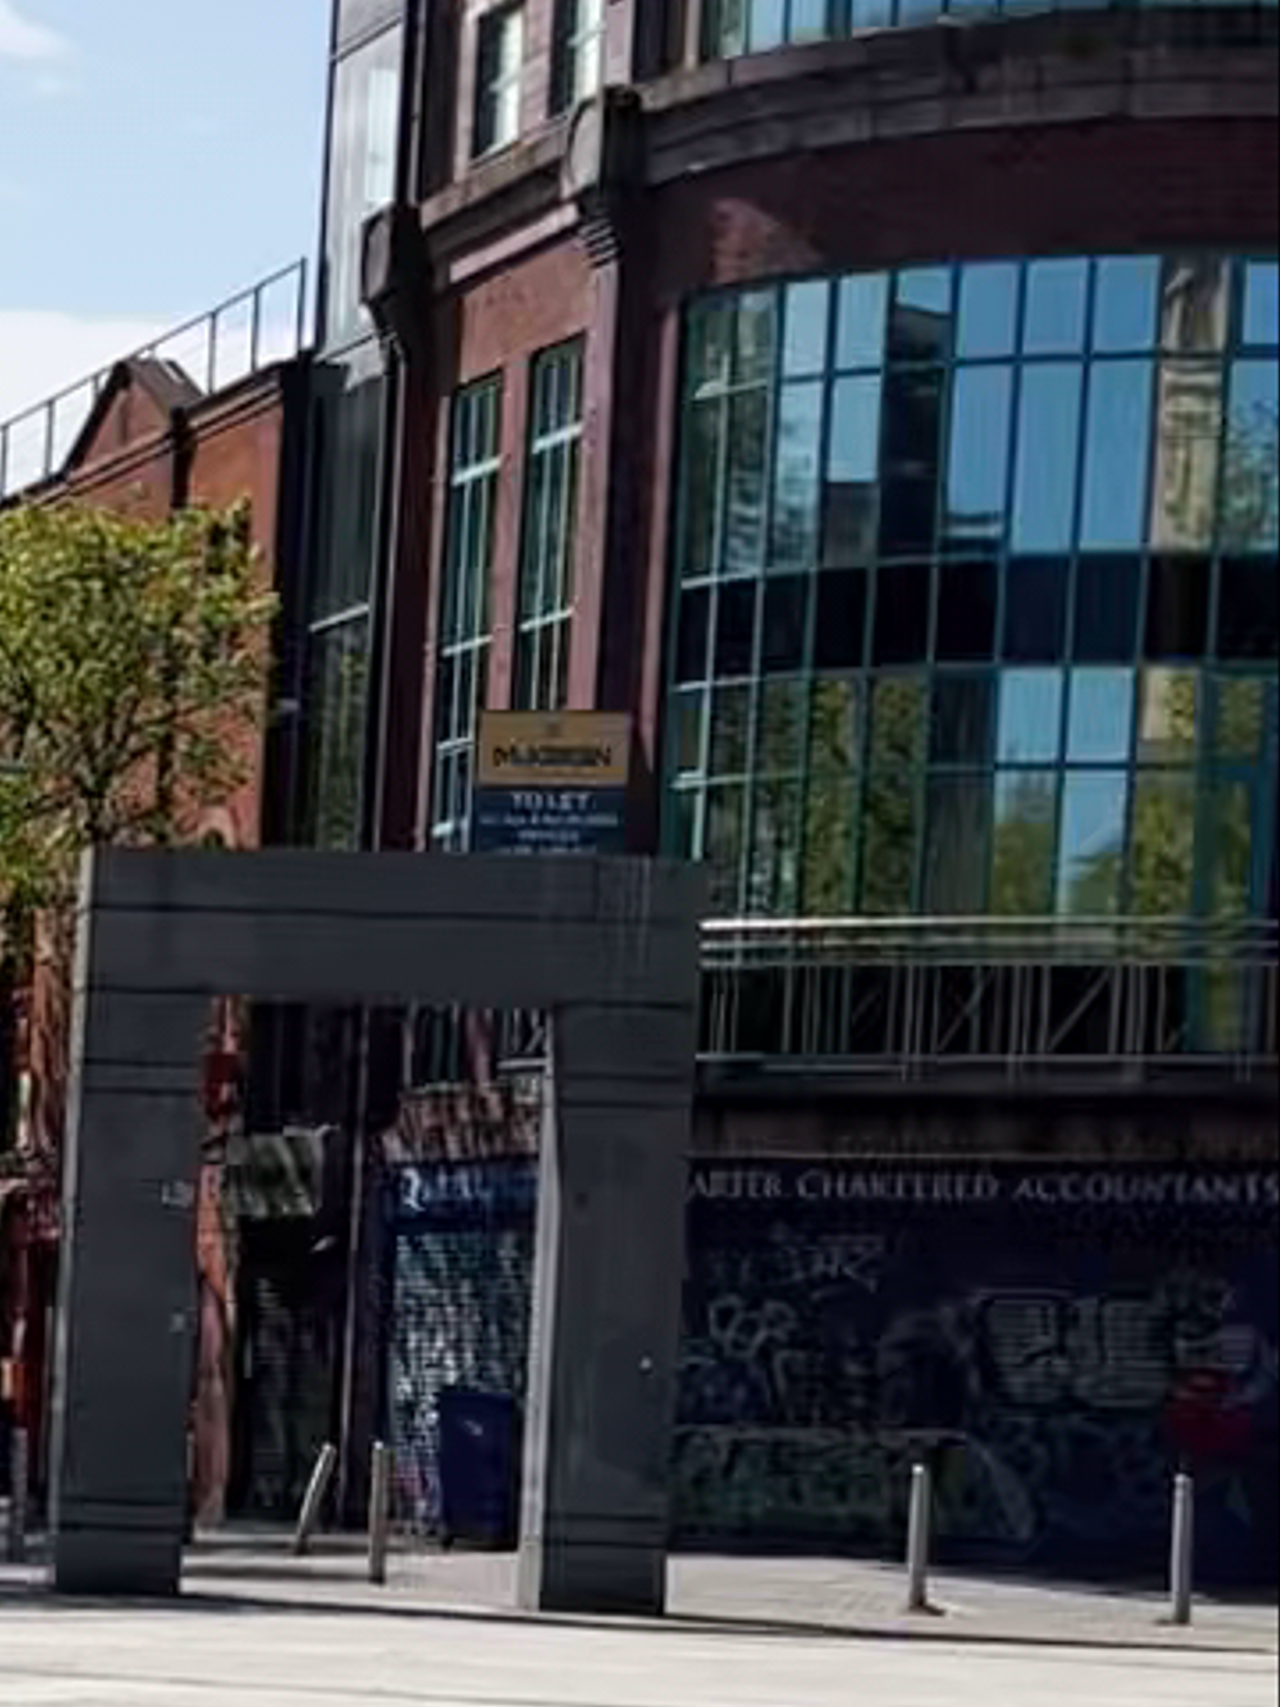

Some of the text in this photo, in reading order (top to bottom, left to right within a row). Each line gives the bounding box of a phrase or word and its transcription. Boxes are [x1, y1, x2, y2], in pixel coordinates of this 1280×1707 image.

[688, 1168, 1280, 1204] ARTER CHARTERED ACCOUNTANTS
